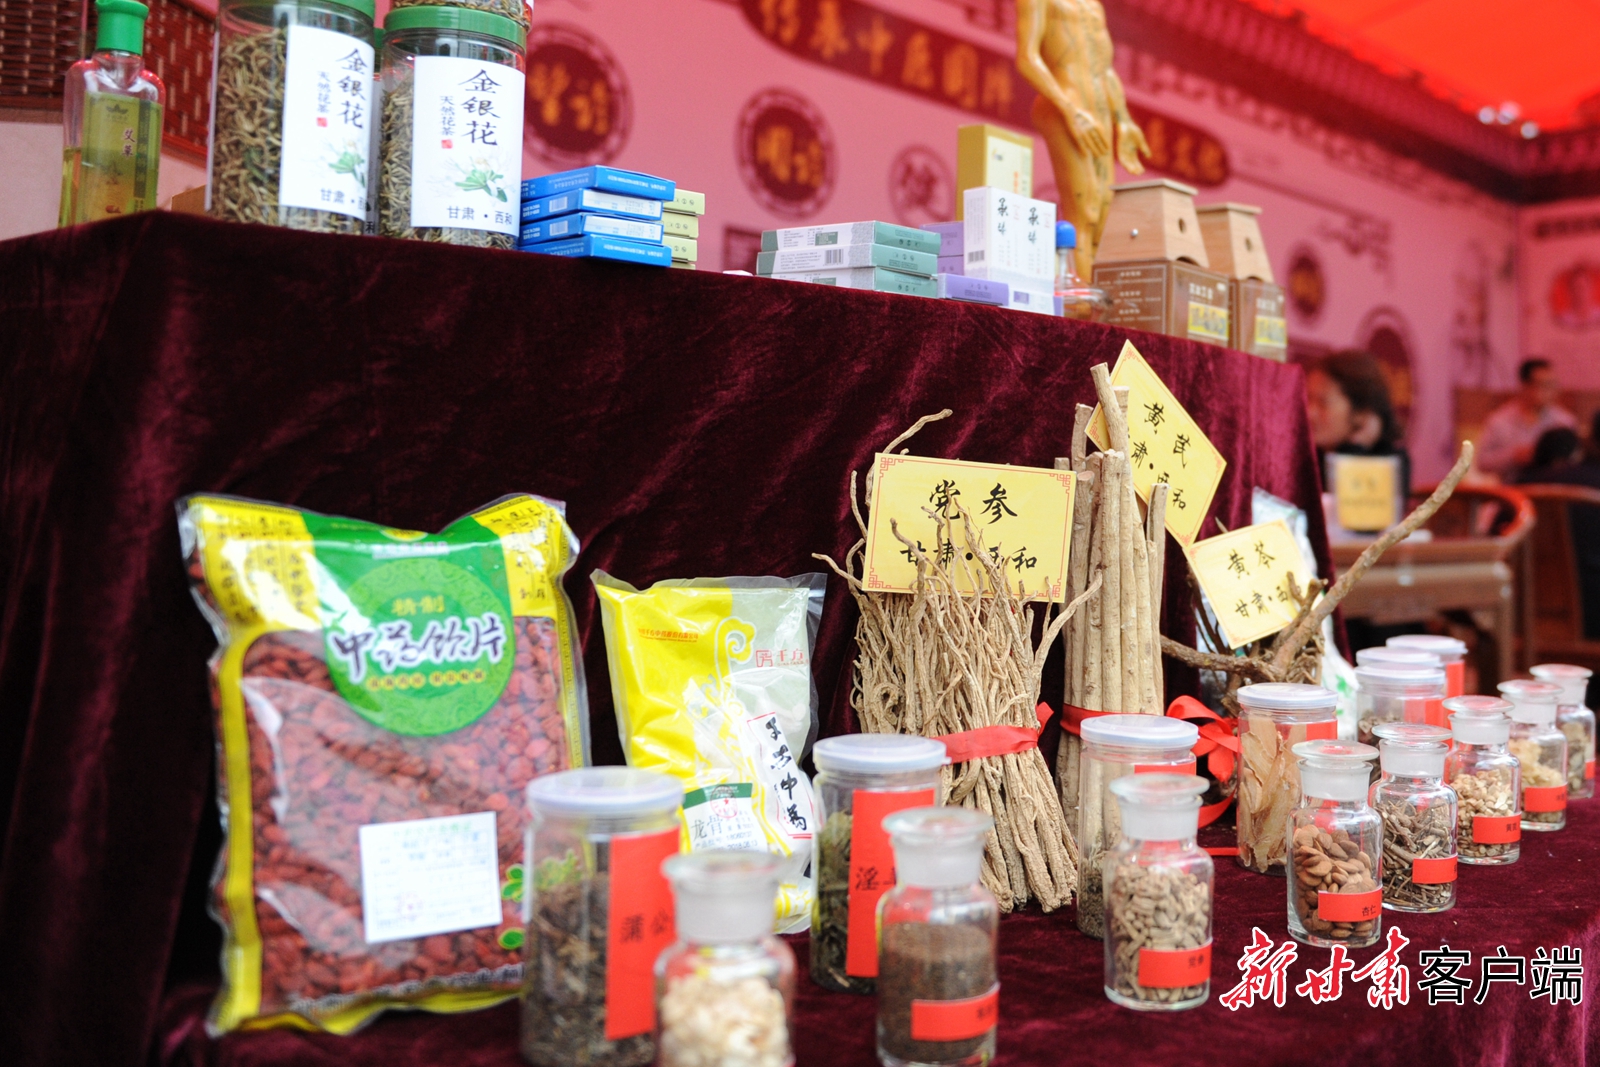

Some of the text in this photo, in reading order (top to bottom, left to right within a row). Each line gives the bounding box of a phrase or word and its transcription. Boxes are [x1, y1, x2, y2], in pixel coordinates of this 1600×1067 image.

[335, 48, 368, 129] 金银花
[457, 69, 502, 146] 金银花
[440, 95, 456, 136] 天然花茶
[929, 479, 1018, 524] 党参
[1361, 904, 1376, 917] 杏仁
